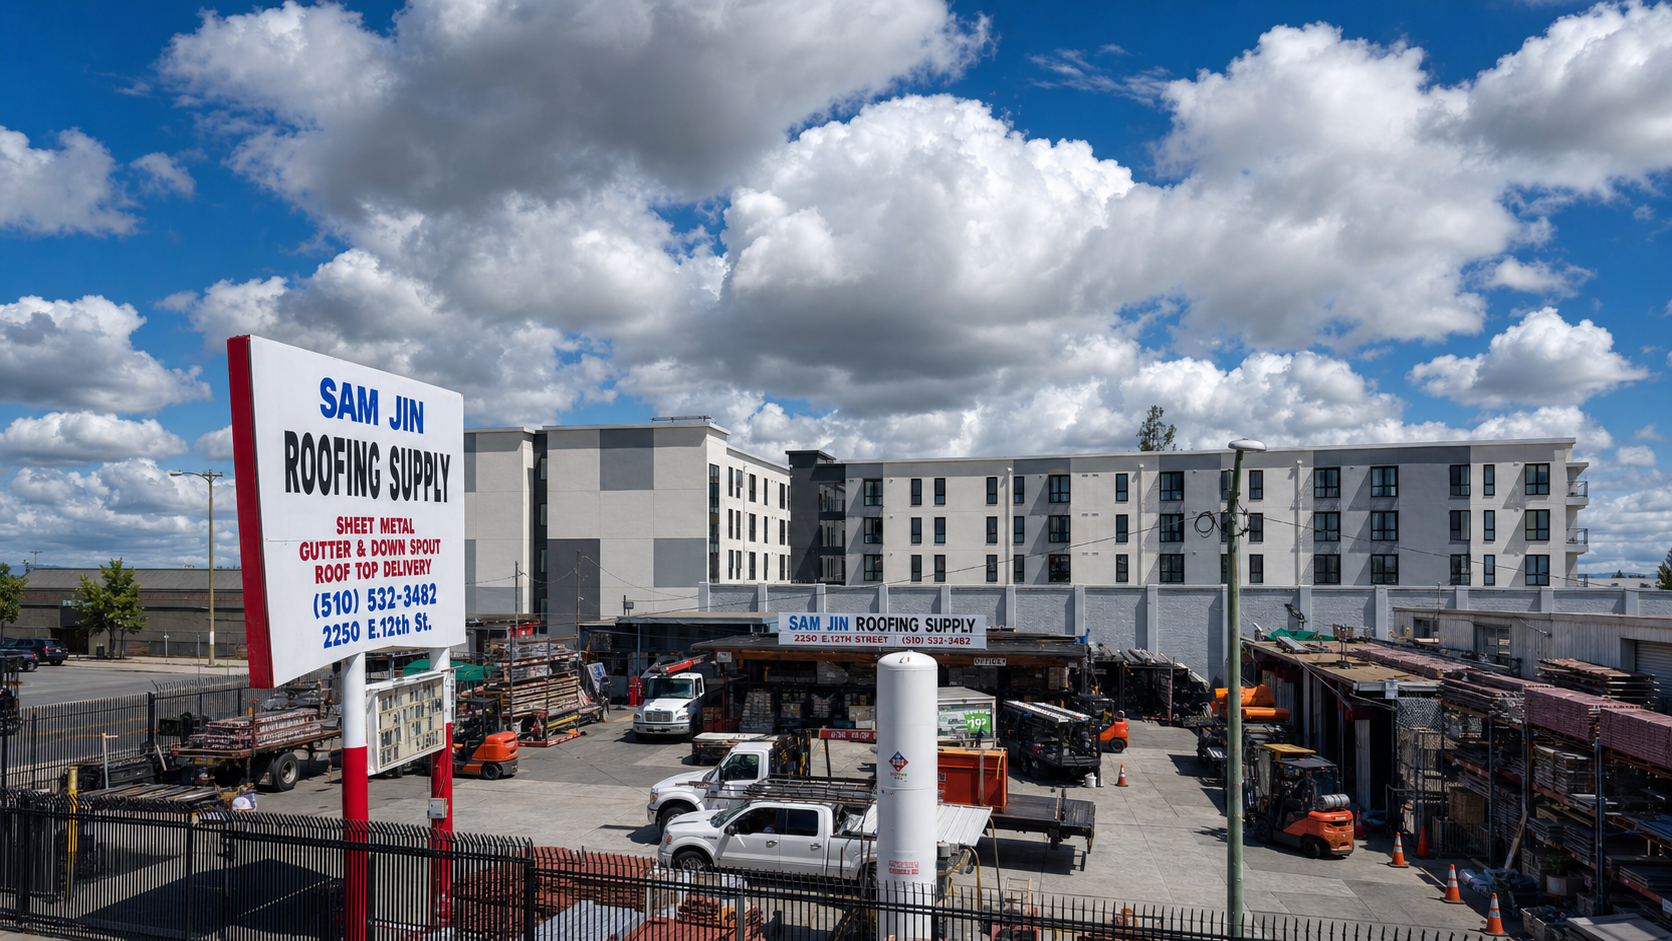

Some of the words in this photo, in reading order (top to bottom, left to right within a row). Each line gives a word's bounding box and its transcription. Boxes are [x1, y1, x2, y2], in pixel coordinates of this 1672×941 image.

[319, 377, 379, 426] SAM
[389, 395, 424, 434] JIN
[284, 430, 380, 500] ROOFING
[389, 445, 451, 503] SUPPLY
[336, 516, 375, 535] SHEET
[380, 517, 415, 534] METAL
[299, 540, 352, 562] GUTTER
[357, 541, 366, 557] &
[371, 539, 406, 557] DOWN
[410, 539, 441, 555] SPOUT
[315, 563, 350, 584] ROOF
[355, 561, 379, 580] TOP
[383, 559, 432, 579] DELIVERY
[313, 588, 360, 619] (510)
[367, 583, 437, 612] 532-3482
[323, 620, 361, 649] 2250
[368, 614, 410, 640] E.12th
[414, 612, 432, 632] St.
[789, 615, 820, 631] SAM
[827, 616, 849, 631] JIN
[856, 616, 919, 633] ROOFING
[925, 617, 976, 633] SUPPLY
[794, 634, 818, 642] 2250
[821, 635, 852, 643] E.12TH
[855, 635, 888, 644] STREET
[902, 636, 924, 645] (510)
[927, 637, 971, 645] 532-3482
